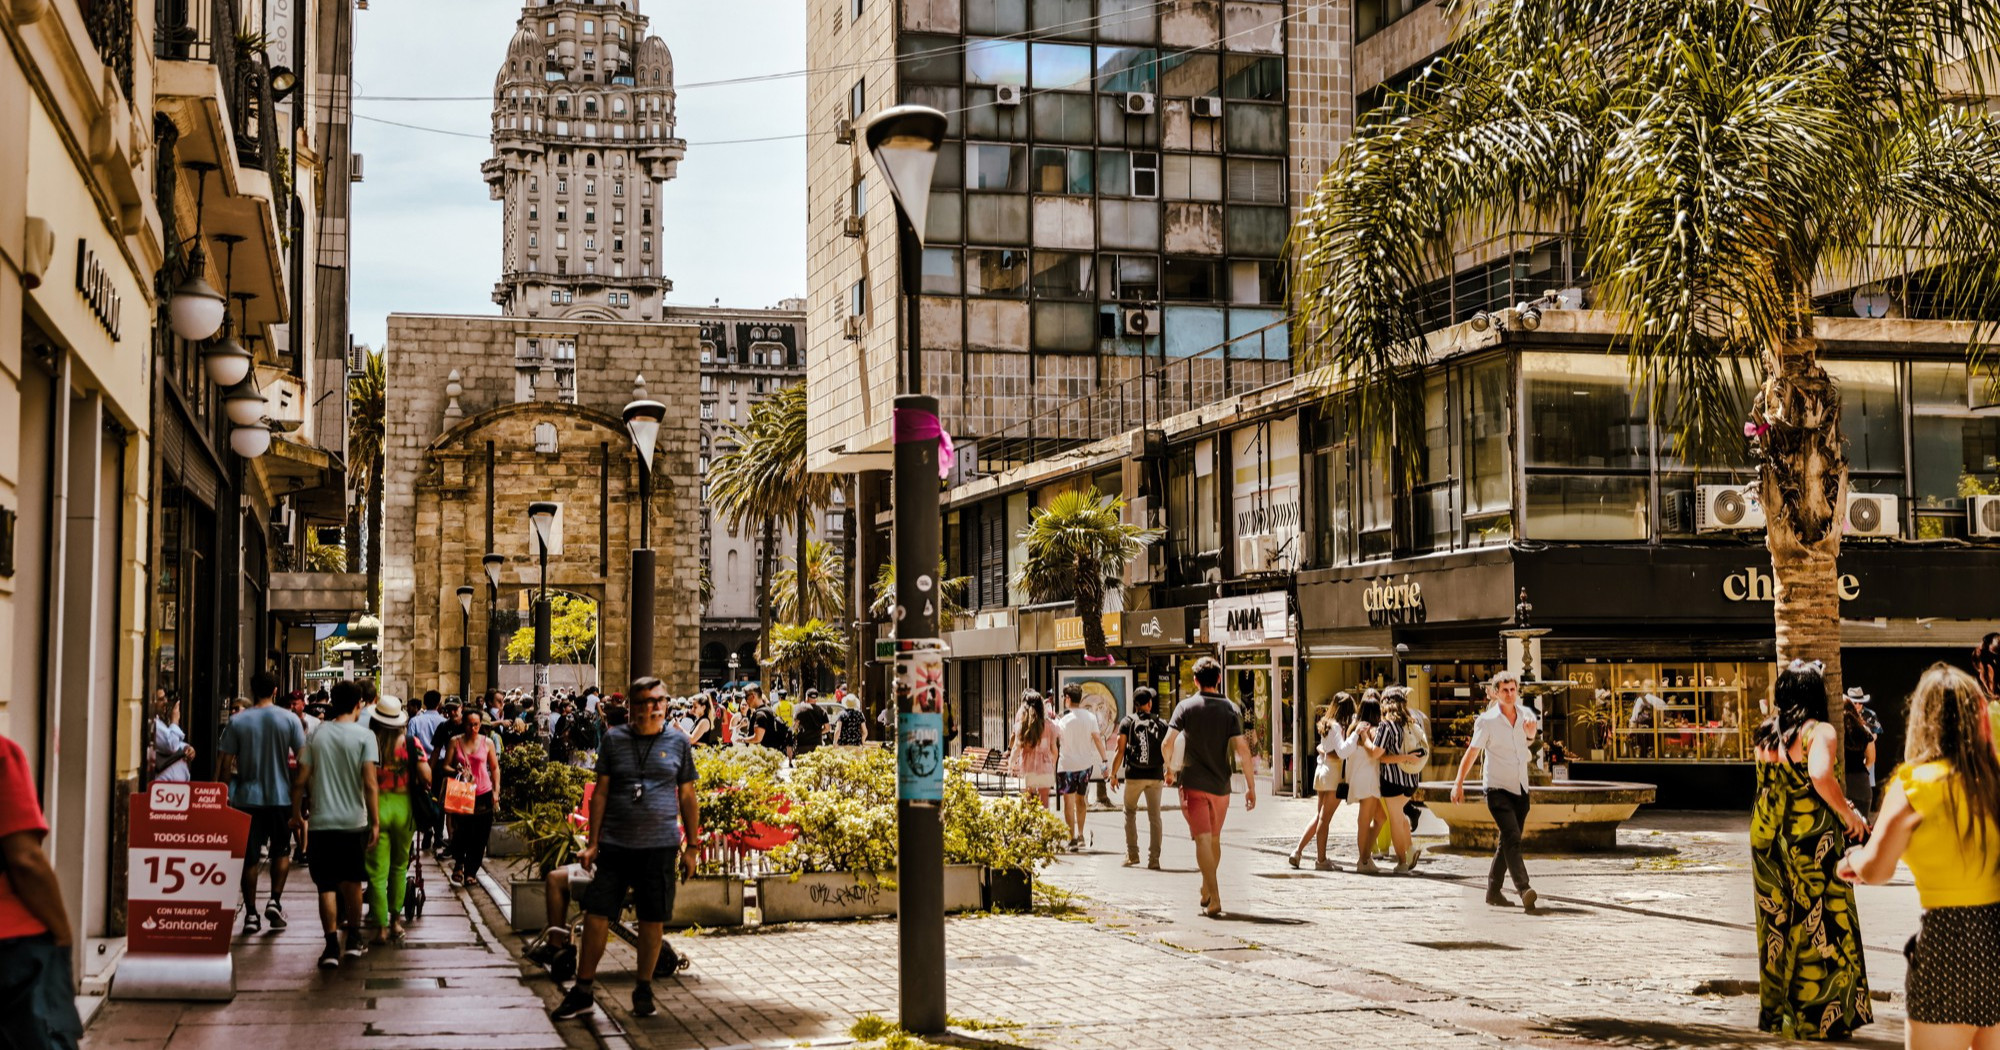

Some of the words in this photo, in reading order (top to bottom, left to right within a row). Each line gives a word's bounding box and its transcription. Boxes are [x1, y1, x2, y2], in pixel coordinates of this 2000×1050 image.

[1722, 567, 1860, 601] che
[1362, 573, 1421, 612] chérie
[1226, 606, 1264, 632] AMMA
[1568, 671, 1594, 684] 676
[1139, 730, 1148, 763] Reebok
[155, 788, 185, 807] Soy
[194, 787, 221, 795] CANJEÁ
[198, 795, 216, 803] AQUÍ
[149, 812, 188, 820] Santander
[154, 833, 185, 842] TODOS
[187, 834, 205, 843] LOS
[207, 833, 228, 844] DÍAS
[144, 857, 227, 894] 15%
[158, 918, 218, 930] Santander
